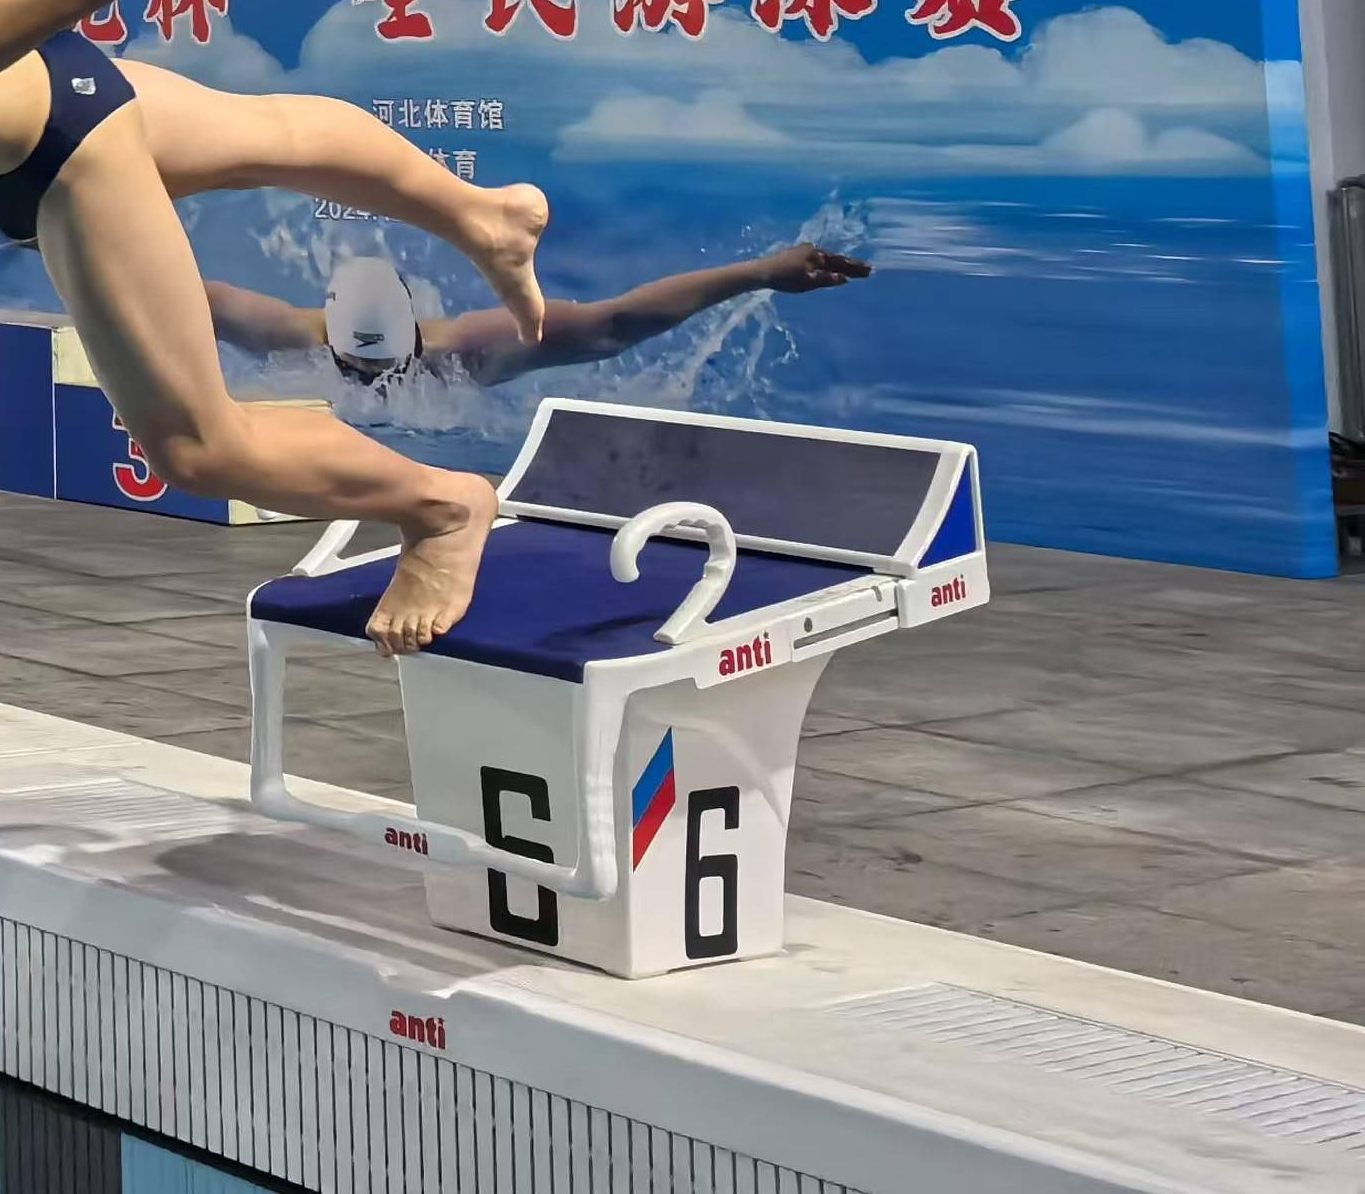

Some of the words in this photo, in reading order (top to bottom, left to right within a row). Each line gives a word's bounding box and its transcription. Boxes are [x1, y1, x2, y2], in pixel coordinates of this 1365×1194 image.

[372, 99, 504, 130] 河北体育馆
[930, 574, 967, 607] anti
[718, 632, 773, 677] anti
[384, 824, 429, 856] anti
[480, 765, 559, 947] 6
[684, 785, 740, 960] 6
[388, 1006, 447, 1050] anti
